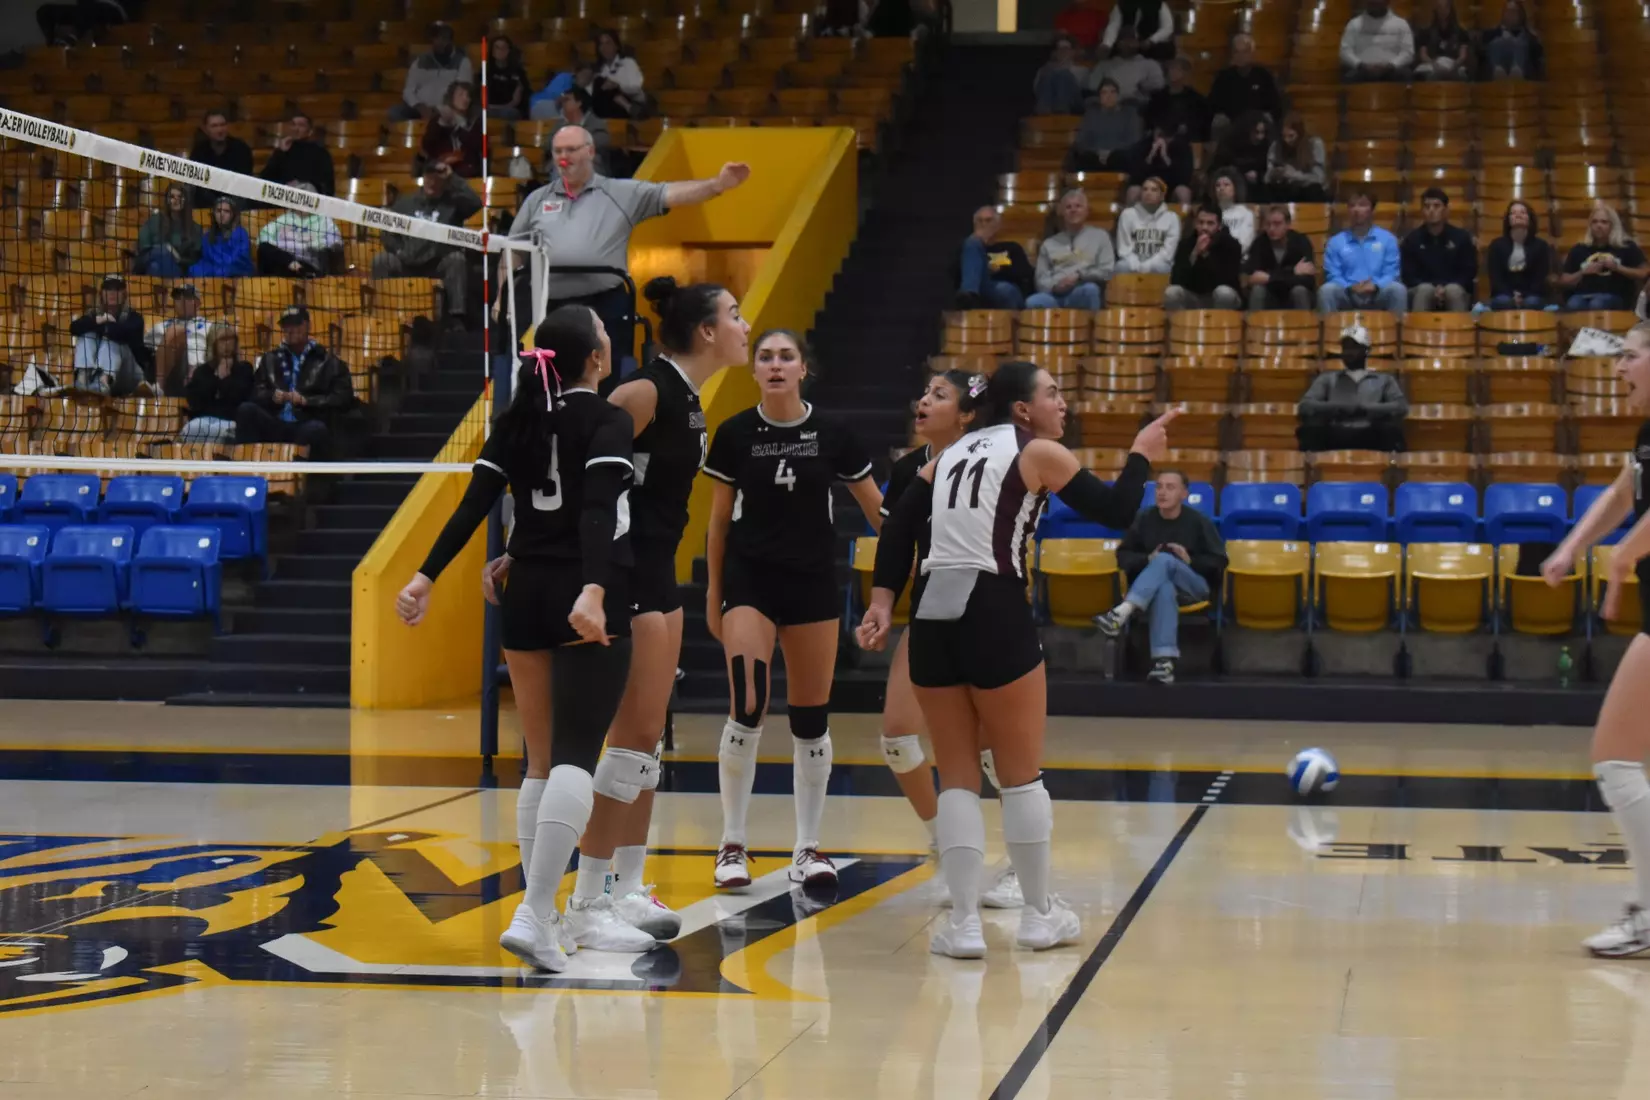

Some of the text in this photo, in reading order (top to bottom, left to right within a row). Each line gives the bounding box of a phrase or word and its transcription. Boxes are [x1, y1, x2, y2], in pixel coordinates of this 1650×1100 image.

[23, 119, 69, 146] VOLLEYBALL
[167, 158, 205, 181] VOLLEYBALL
[751, 441, 819, 457] SALUKIS
[774, 459, 797, 492] 4
[946, 457, 988, 509] 11
